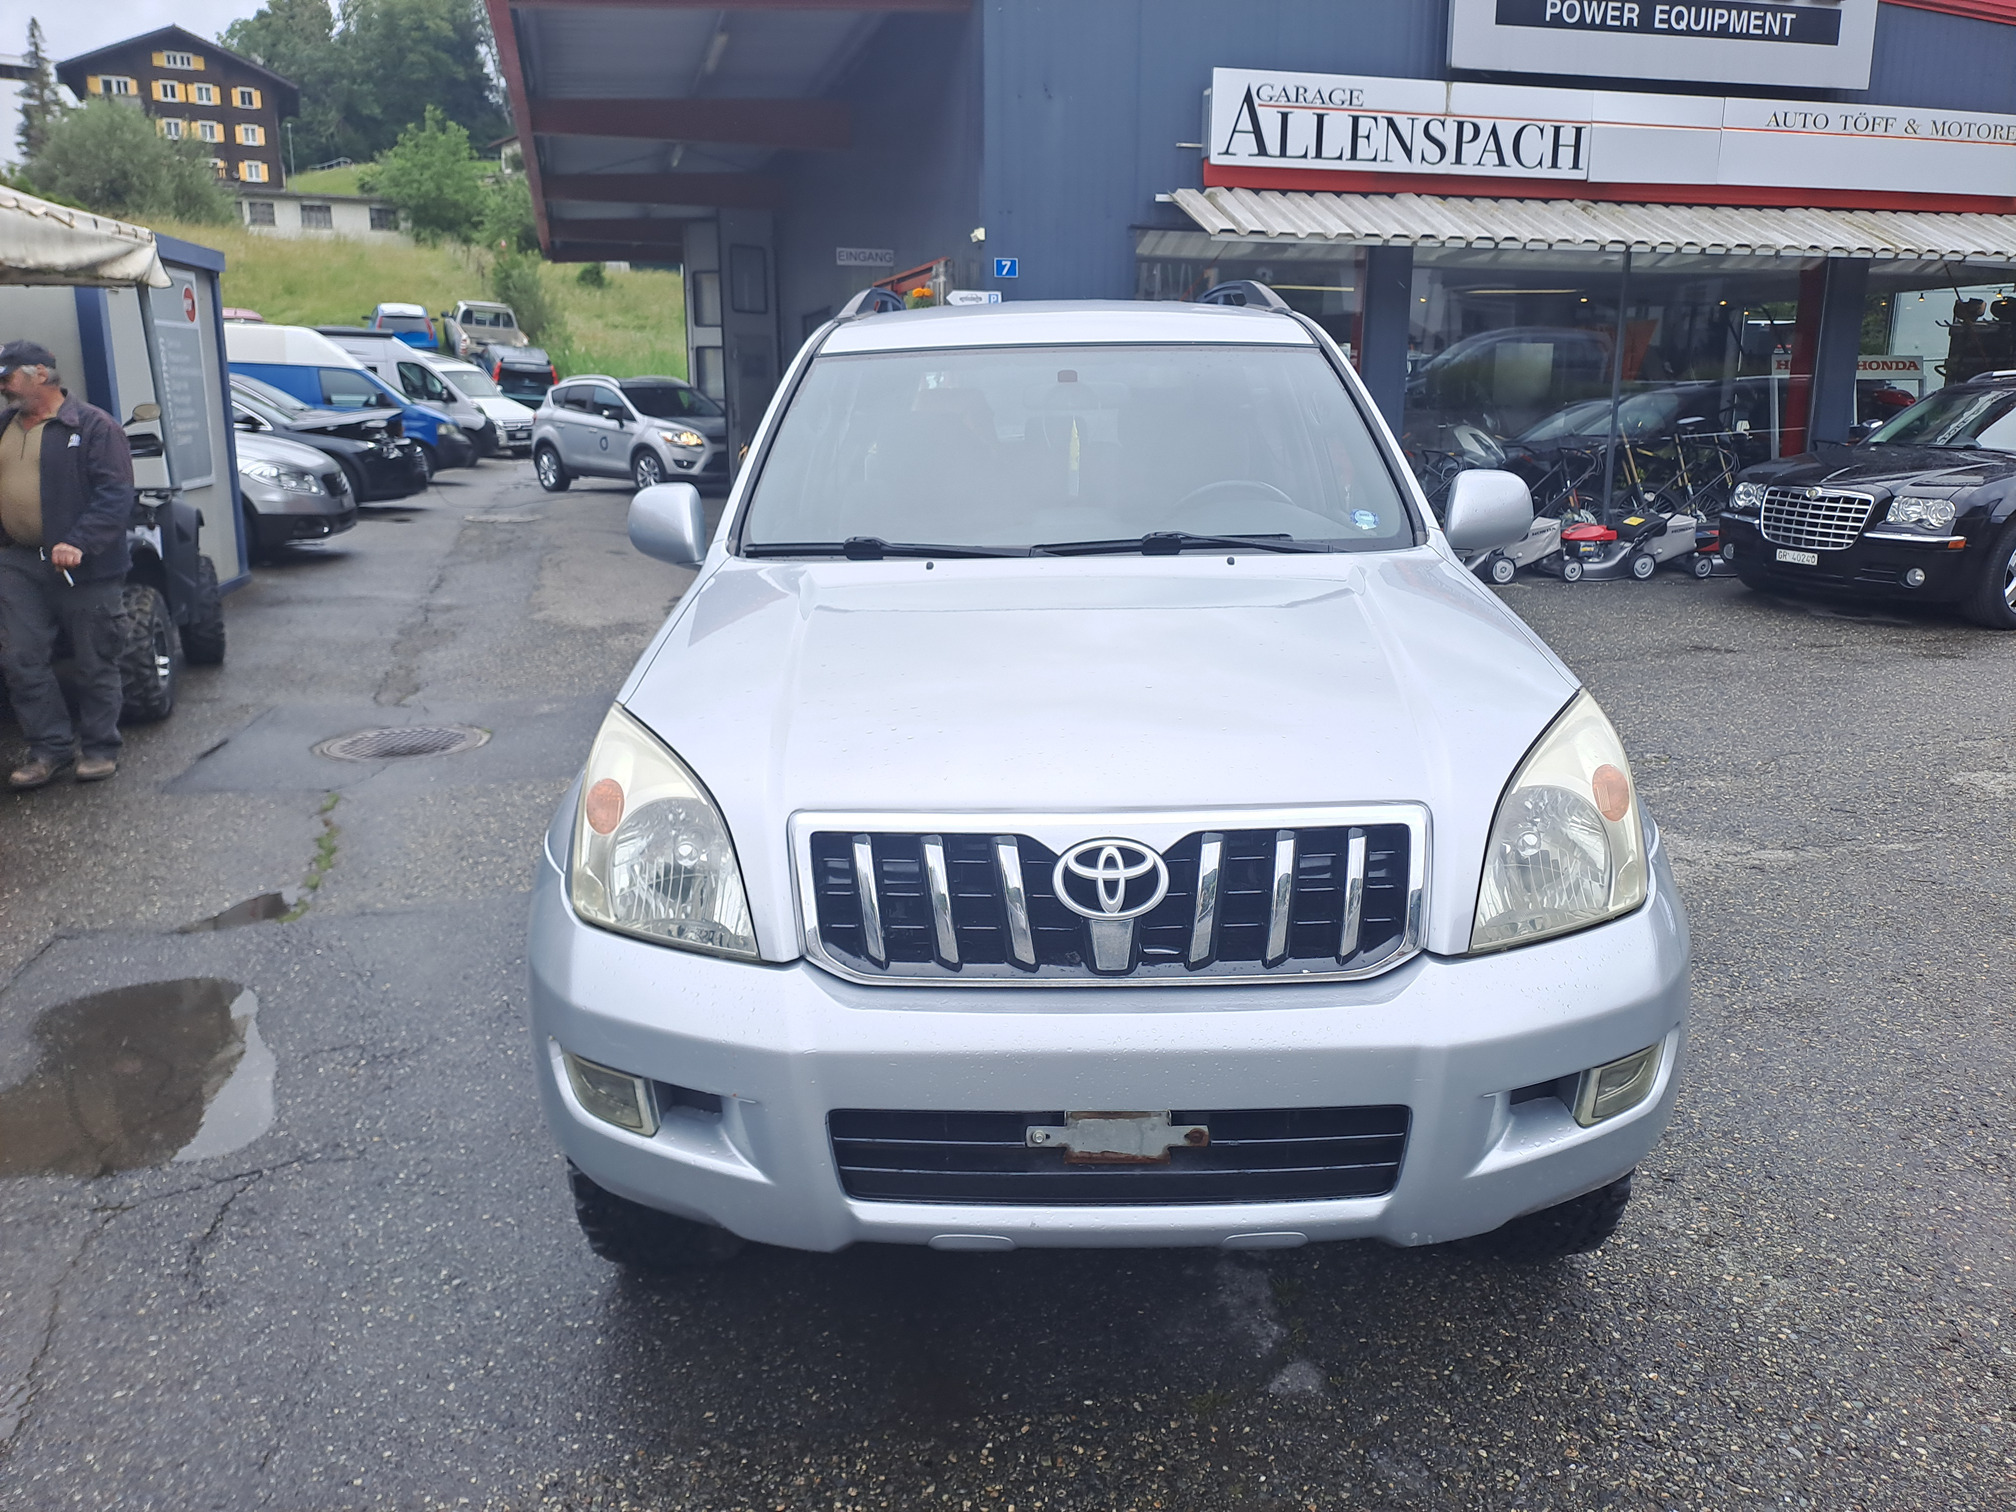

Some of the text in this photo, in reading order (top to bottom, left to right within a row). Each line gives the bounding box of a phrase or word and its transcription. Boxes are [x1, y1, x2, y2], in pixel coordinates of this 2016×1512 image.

[1545, 0, 1797, 37] POWER EQUIPMENT
[1256, 83, 1364, 107] GARAGE
[1217, 83, 1587, 170] ALLENSPACH
[1766, 111, 2016, 141] AUTO TÖFF & MOTORE
[837, 251, 893, 263] EINGANG
[1001, 261, 1011, 275] 7
[1856, 360, 1919, 371] HONDA
[1778, 551, 1787, 560] GR
